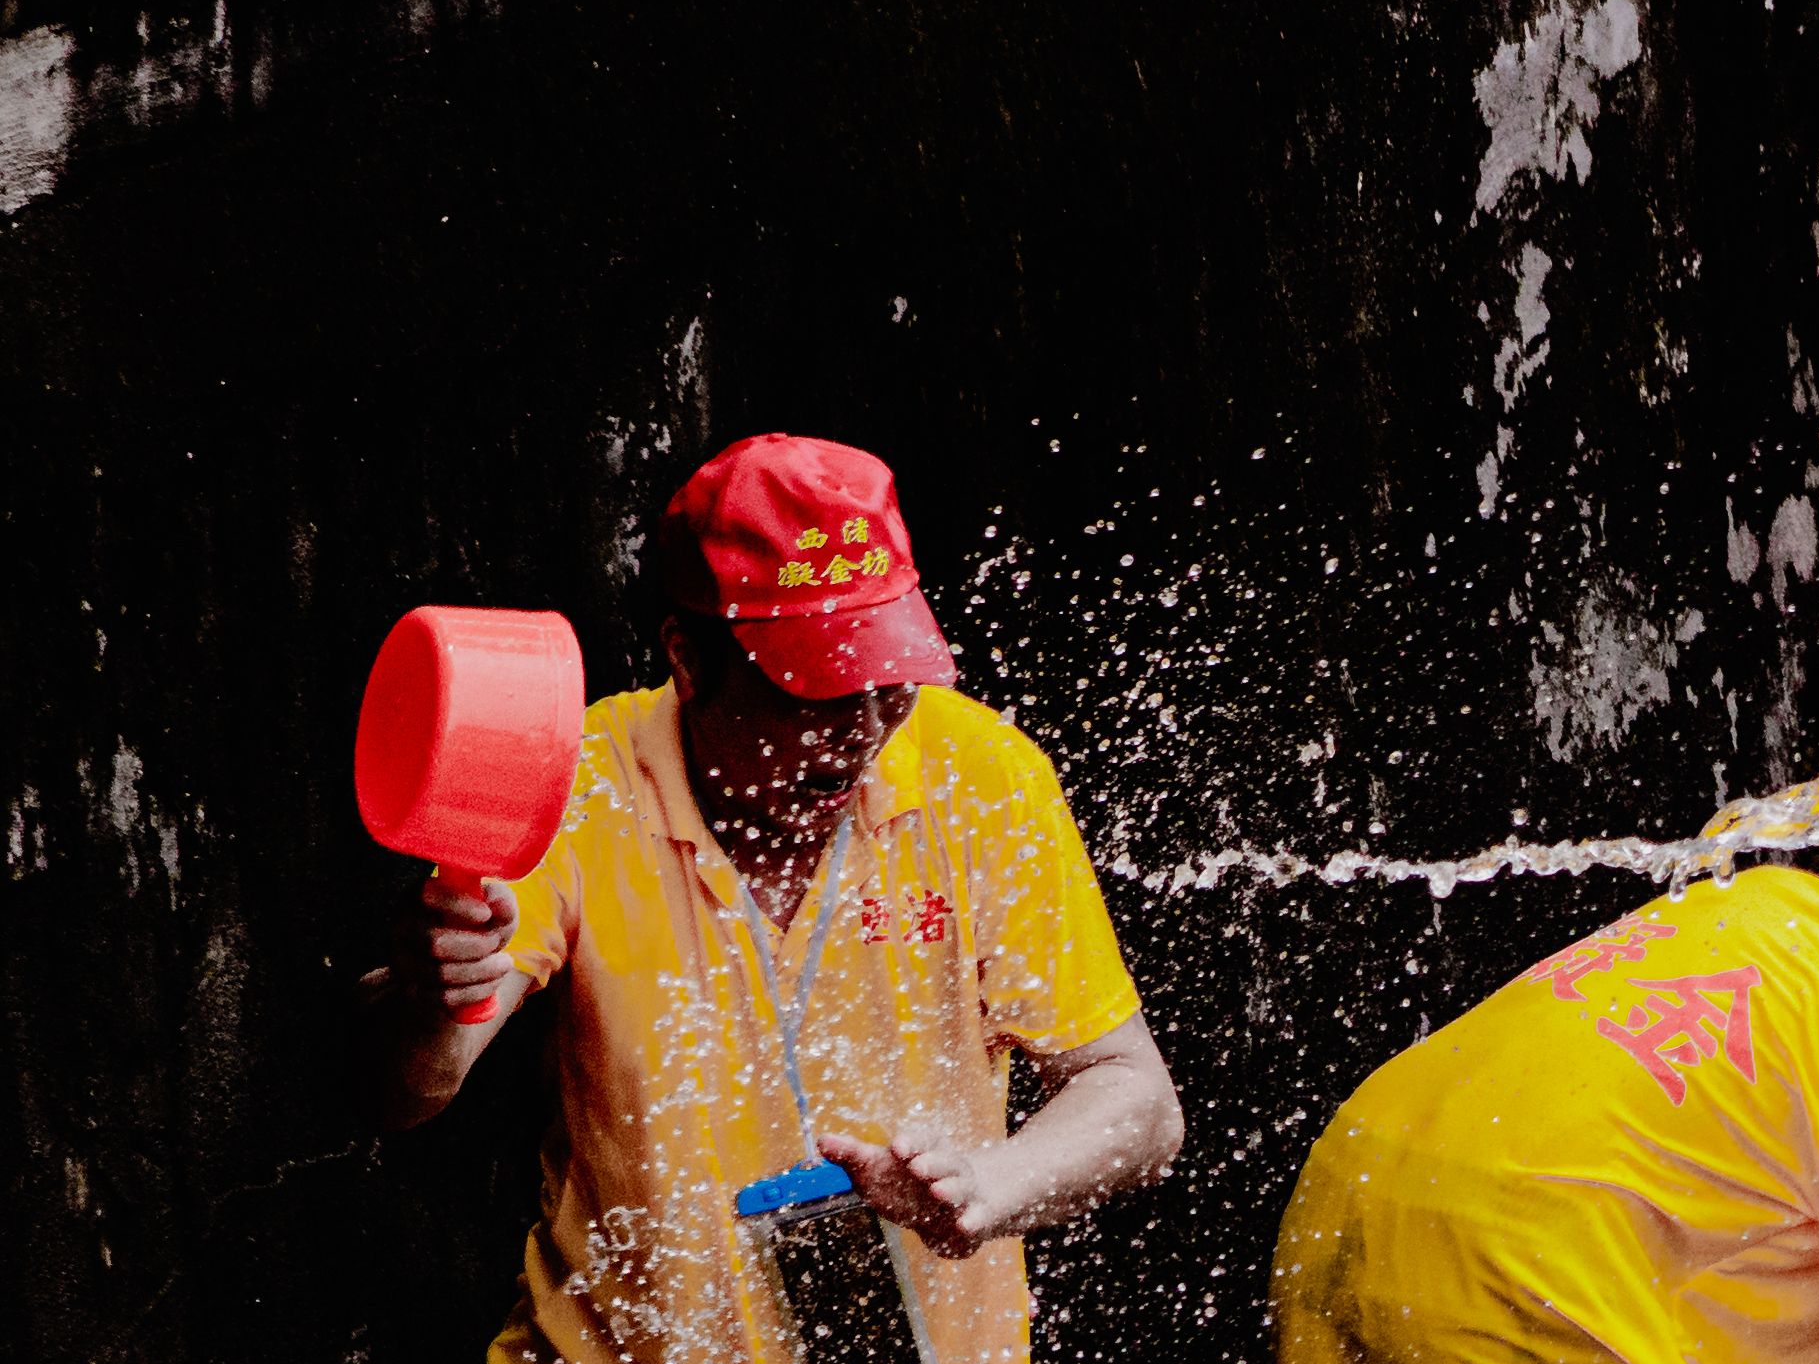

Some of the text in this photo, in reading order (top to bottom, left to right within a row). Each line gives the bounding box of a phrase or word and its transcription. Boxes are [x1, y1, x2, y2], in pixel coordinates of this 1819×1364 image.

[796, 516, 869, 551] 西渚
[777, 545, 890, 589] 凝金坊
